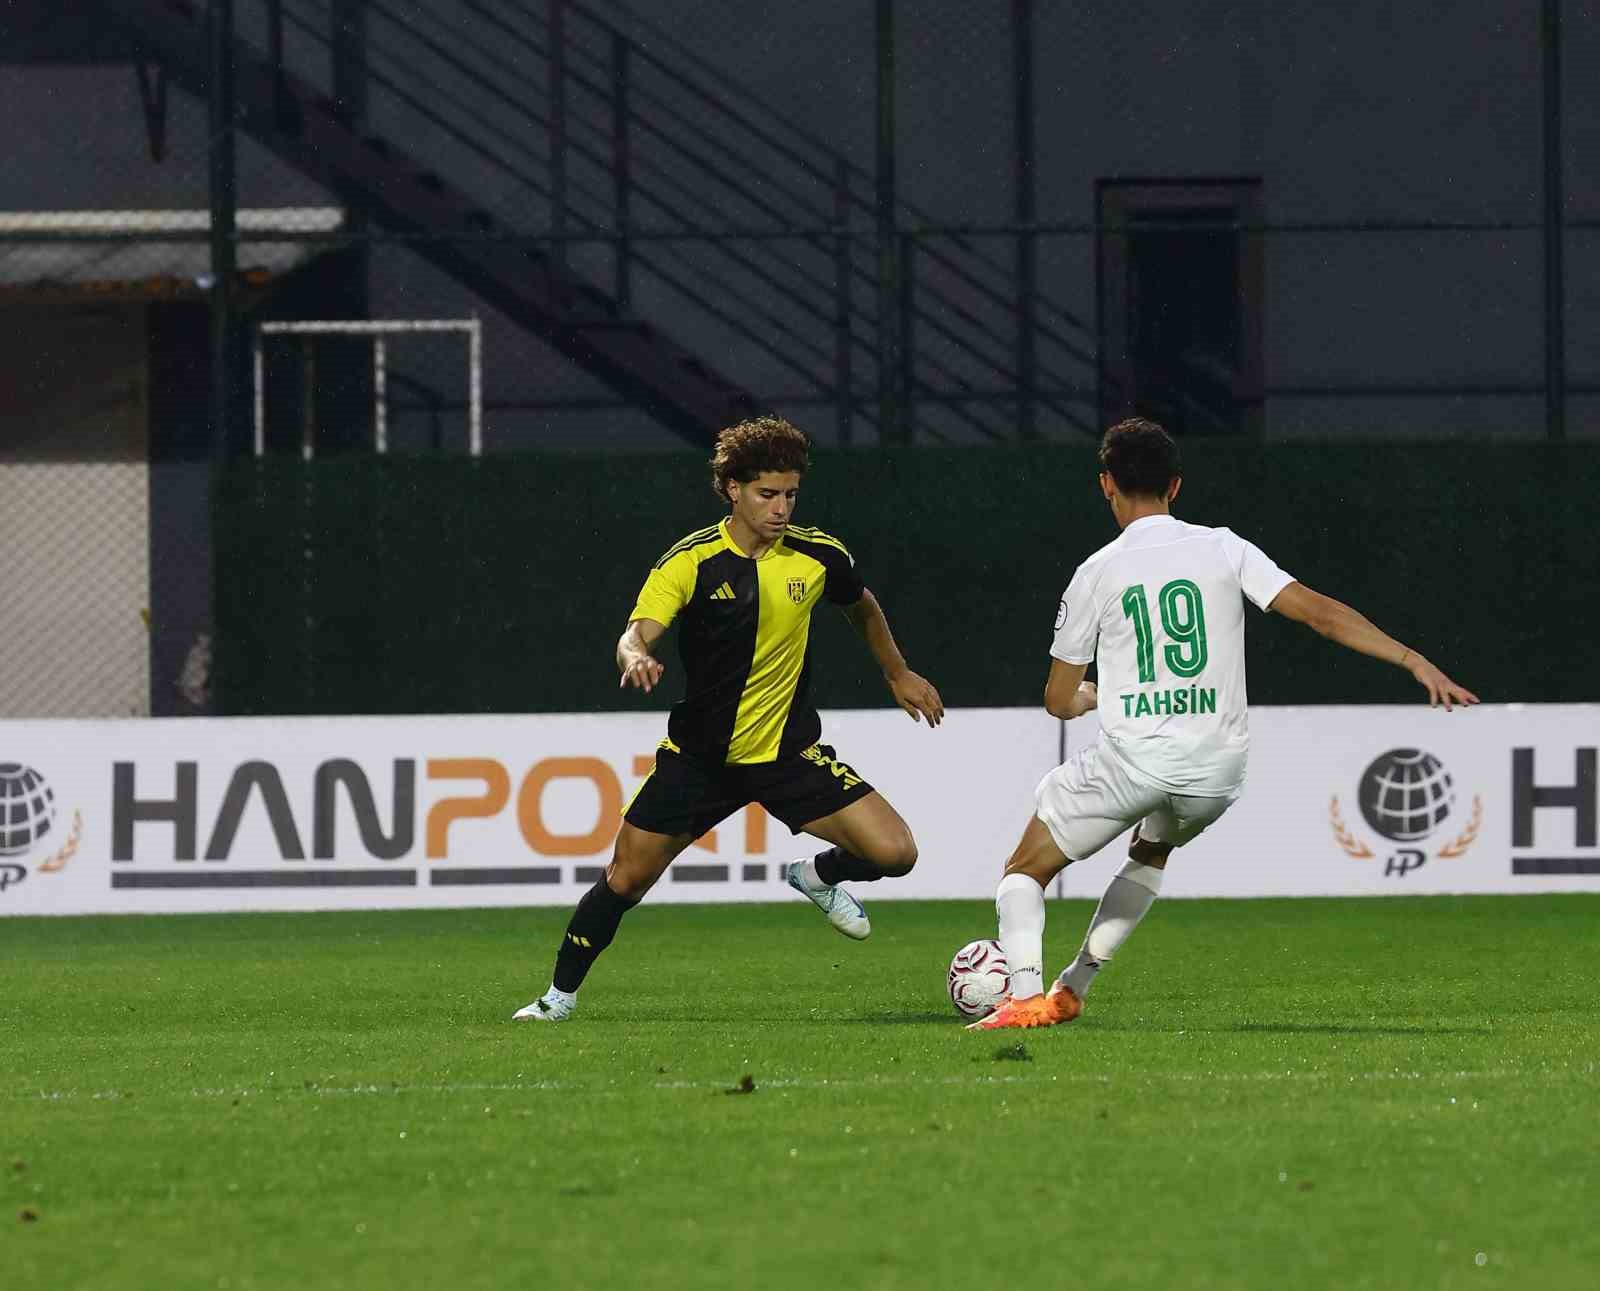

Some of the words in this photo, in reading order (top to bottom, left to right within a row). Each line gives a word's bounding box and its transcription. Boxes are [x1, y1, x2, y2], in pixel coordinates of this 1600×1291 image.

[1121, 579, 1208, 683] 19
[1120, 684, 1216, 718] TAHSİN
[111, 757, 767, 862] HANPO
